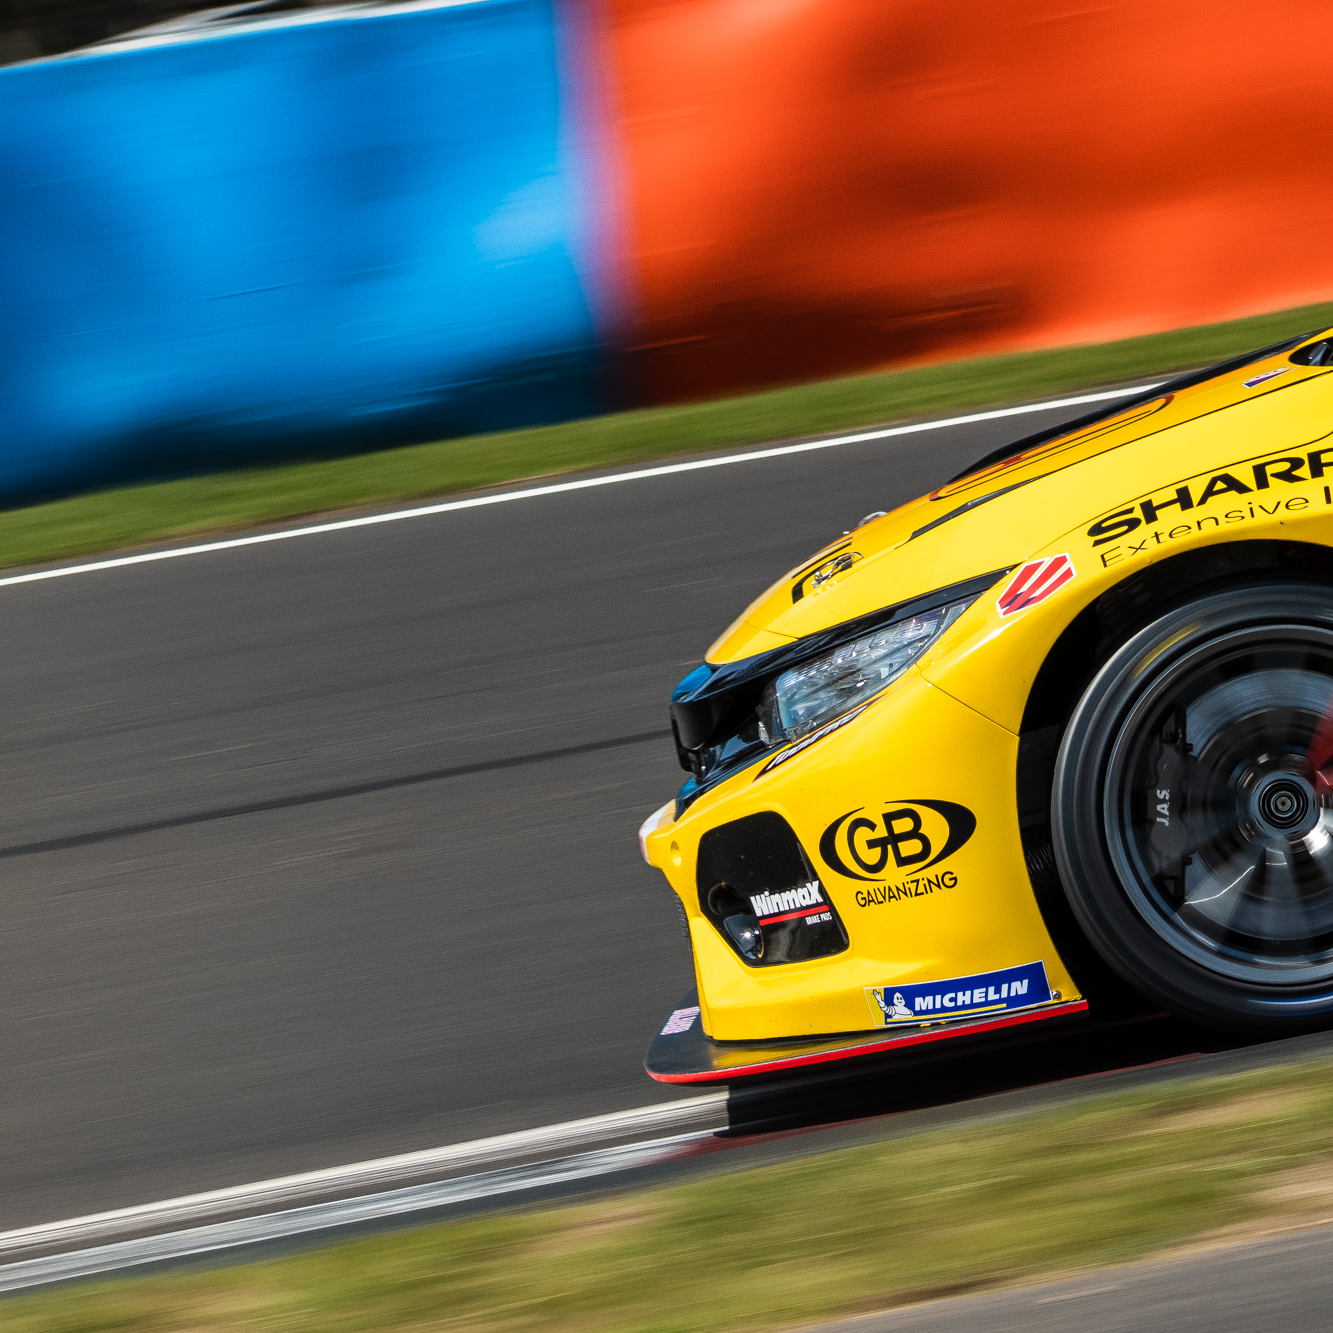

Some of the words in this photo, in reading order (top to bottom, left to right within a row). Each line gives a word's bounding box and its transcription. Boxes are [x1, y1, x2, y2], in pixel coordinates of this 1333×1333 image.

[1100, 495, 1310, 568] Extensive
[846, 807, 932, 874] GB
[805, 913, 821, 926] BRAKE
[820, 911, 833, 924] PADS
[914, 978, 1029, 1012] MICHELIN
